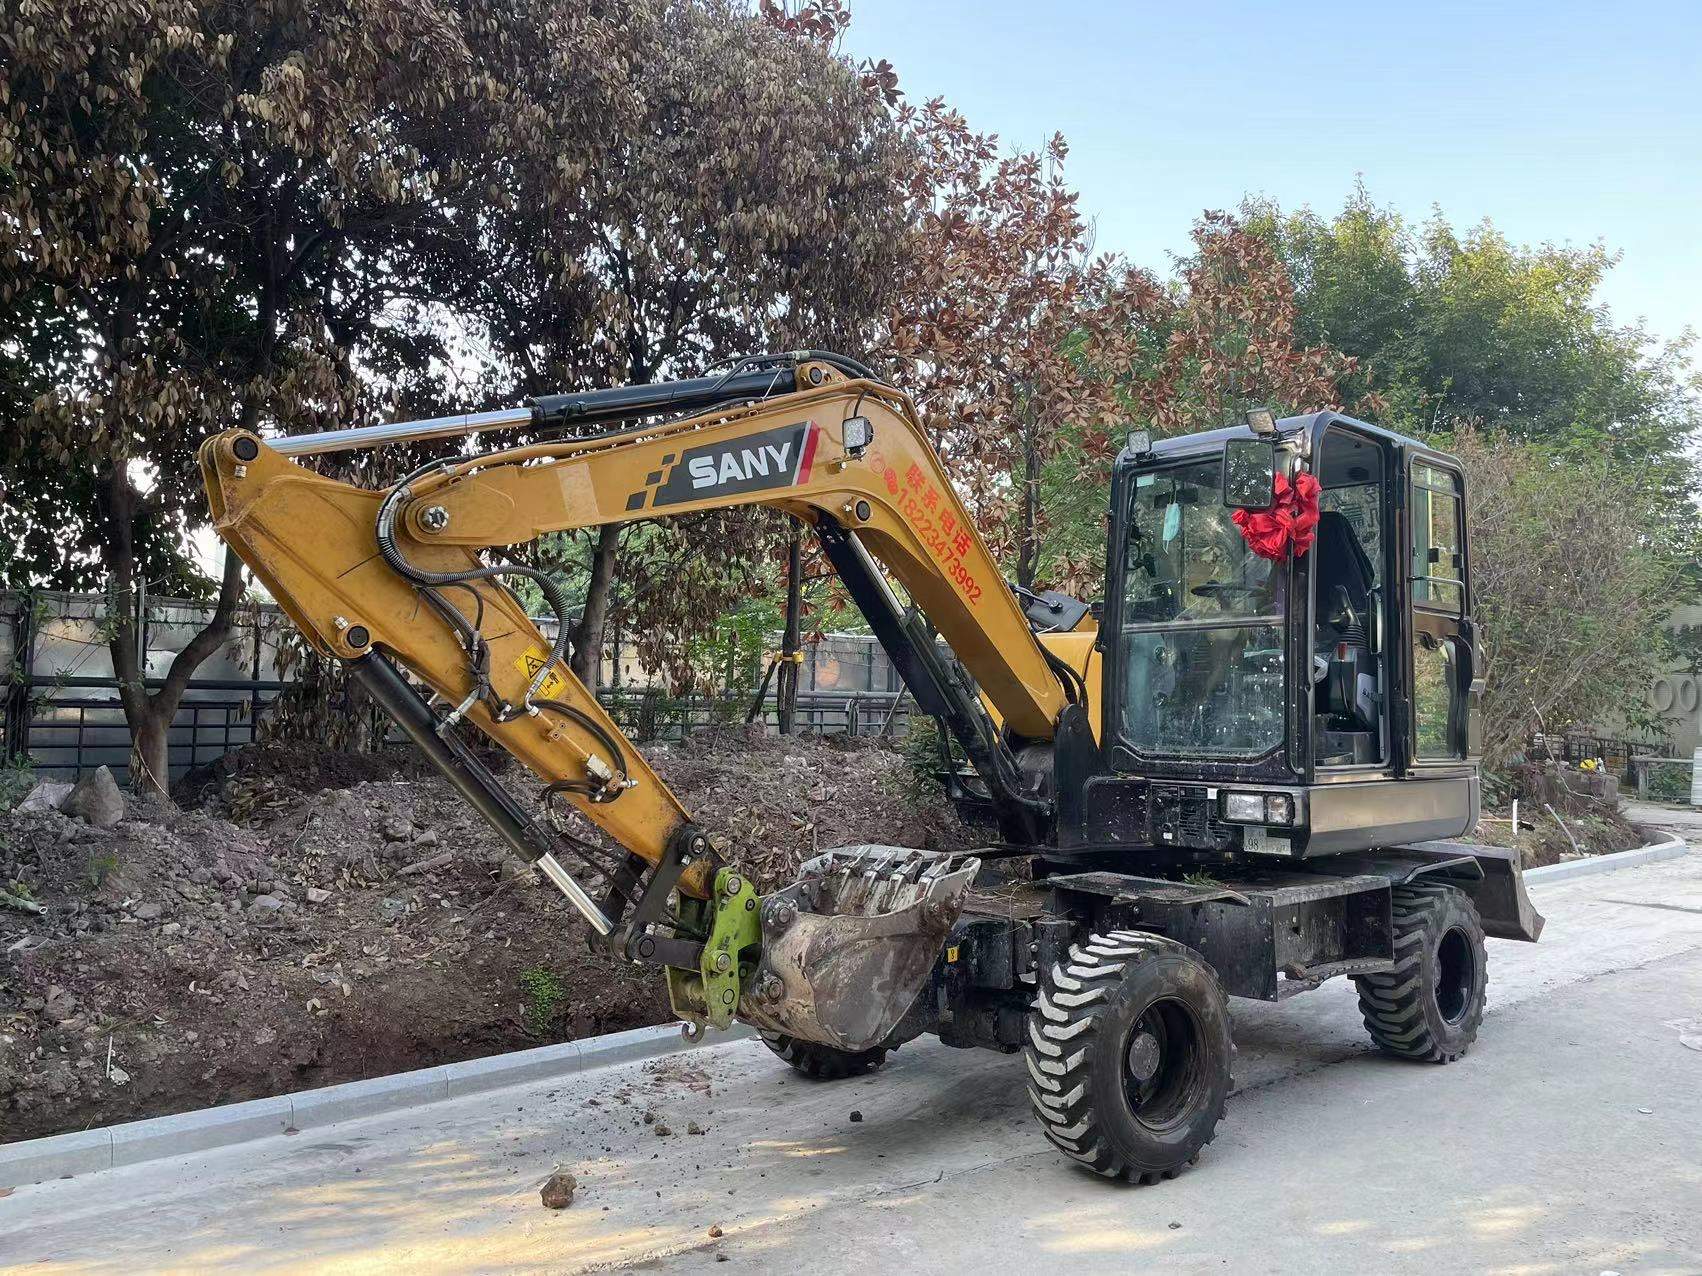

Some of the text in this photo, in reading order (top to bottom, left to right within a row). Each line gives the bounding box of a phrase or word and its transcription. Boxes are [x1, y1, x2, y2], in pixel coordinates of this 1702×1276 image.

[688, 442, 791, 489] SANY
[905, 462, 973, 557] 联系电话
[898, 489, 981, 605] 18223473992
